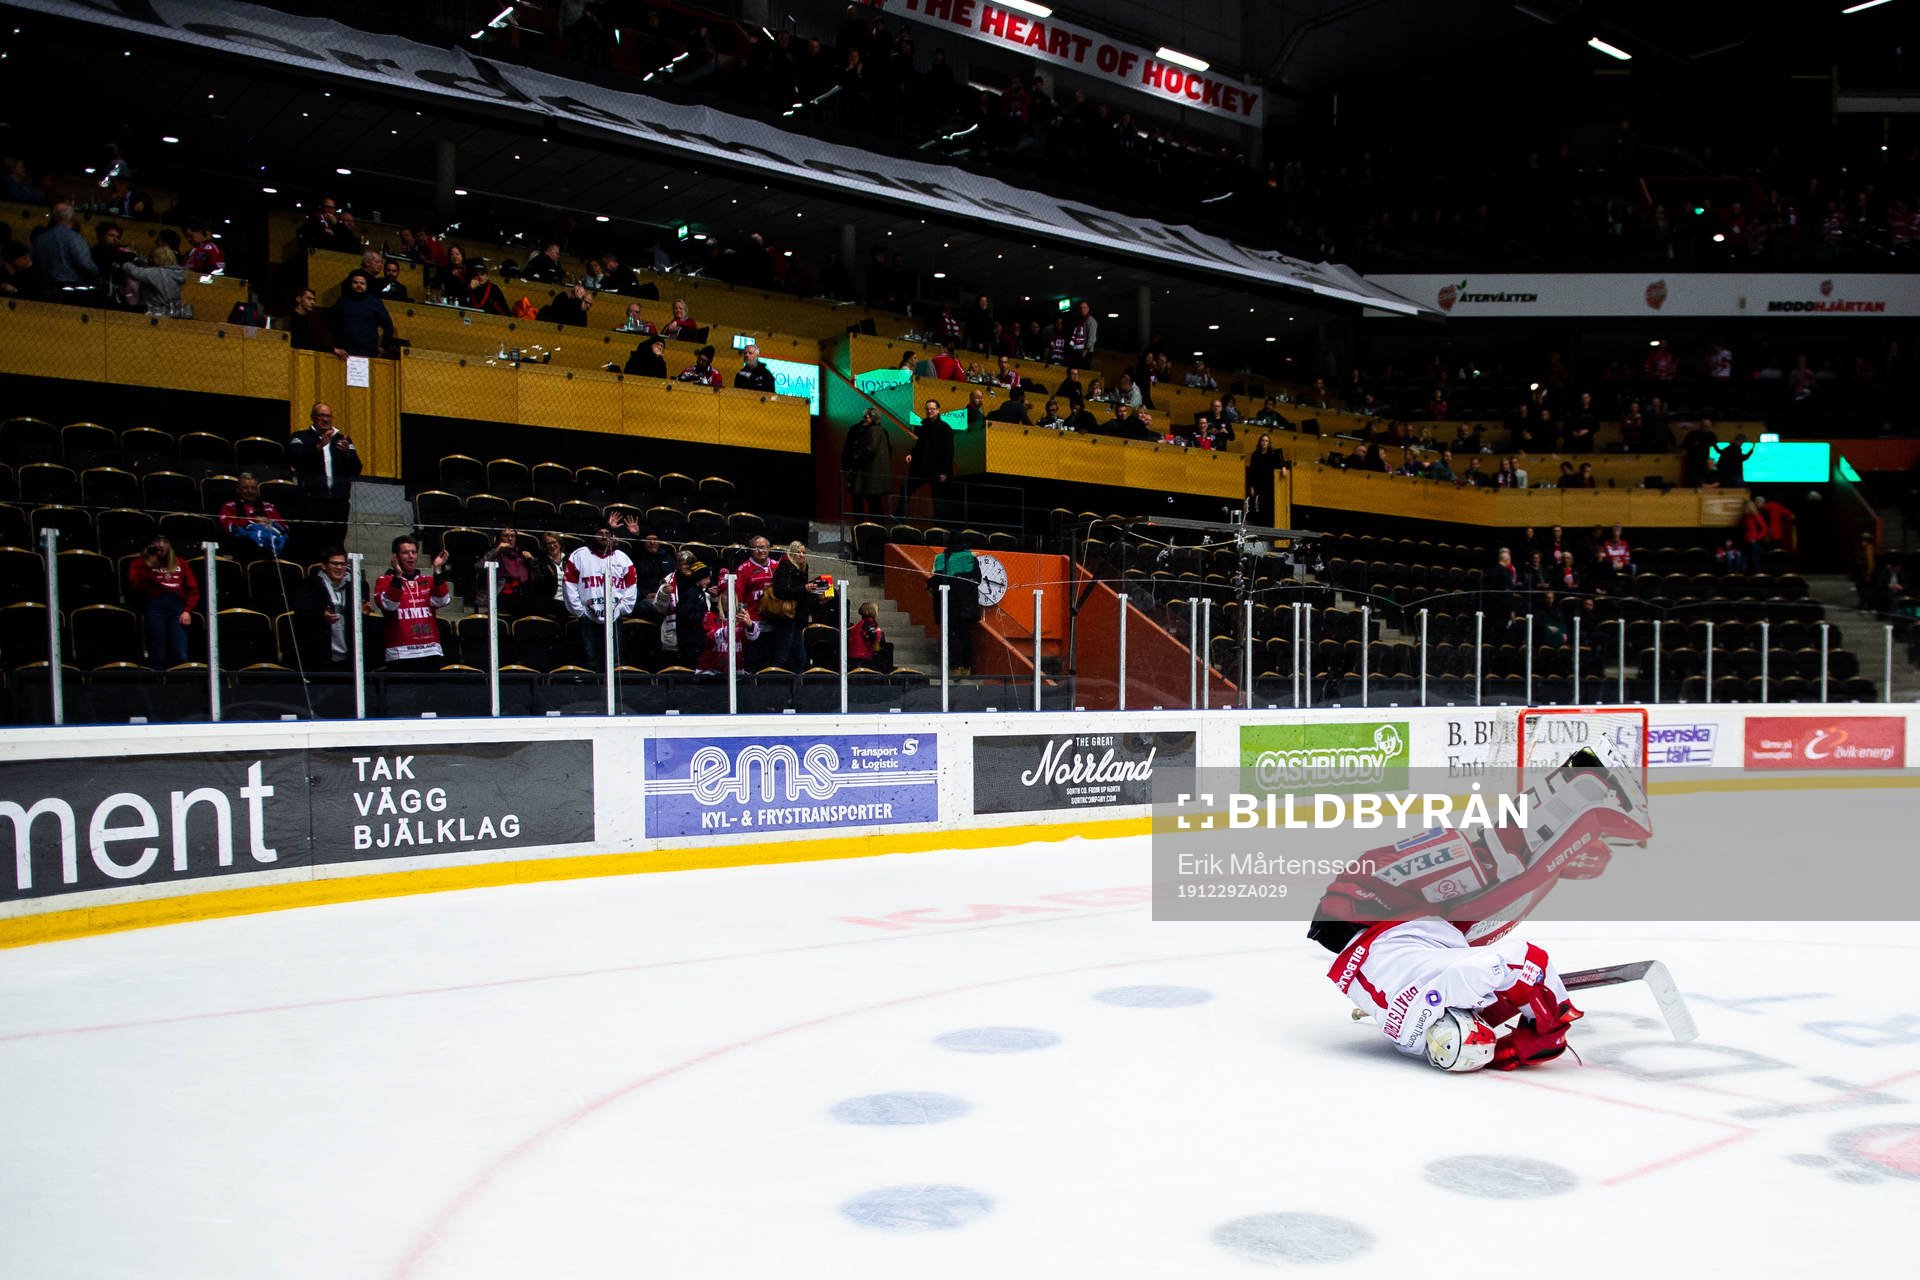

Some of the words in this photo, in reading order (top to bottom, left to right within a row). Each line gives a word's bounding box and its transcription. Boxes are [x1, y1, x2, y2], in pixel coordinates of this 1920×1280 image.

[979, 5, 1093, 65] HEART
[1097, 44, 1139, 77] OF
[1142, 59, 1260, 117] HOCKEY
[1459, 291, 1538, 304] ÅTERVÄXTEN
[1076, 737, 1089, 747] THE
[1092, 736, 1114, 746] GREAT
[1448, 721, 1468, 747] B.
[1647, 724, 1711, 743] svenska
[851, 746, 898, 758] Transport
[851, 759, 860, 769] &
[862, 758, 899, 771] Logistic
[1021, 739, 1157, 787] Norrland
[1858, 747, 1895, 761] energi
[352, 755, 416, 782] TAK
[689, 743, 840, 806] ems
[1260, 753, 1384, 784] CASHBUDDY
[353, 786, 447, 817] VÄGG
[0, 760, 278, 890] ment
[701, 810, 738, 829] KYL-
[741, 809, 753, 827] &
[758, 803, 893, 826] FRYSTRANSPORTER
[353, 814, 520, 850] BJÄLKLAG
[1547, 832, 1592, 873] BAUER
